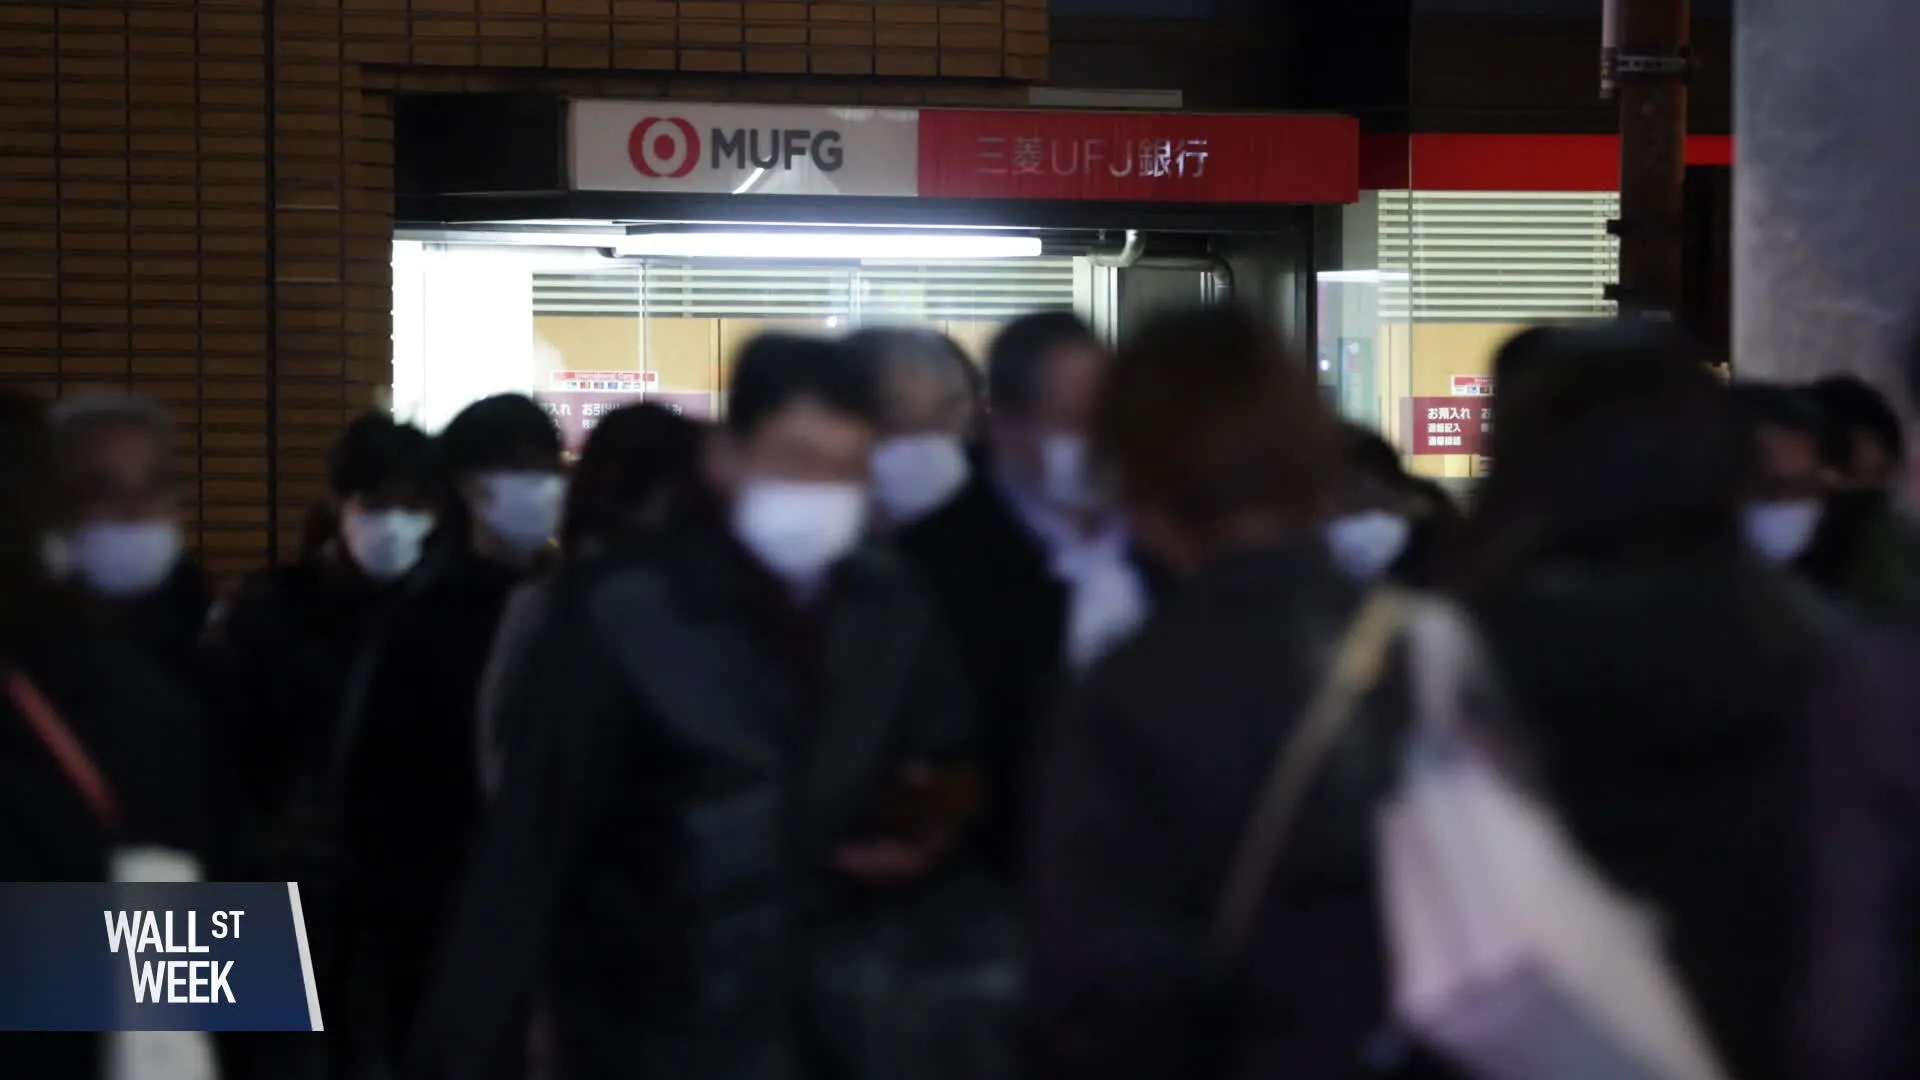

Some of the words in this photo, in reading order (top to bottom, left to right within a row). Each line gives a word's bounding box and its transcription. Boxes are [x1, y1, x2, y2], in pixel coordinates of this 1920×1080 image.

[711, 128, 844, 172] MUFG
[976, 136, 1209, 178] 三菱UFJ銀行
